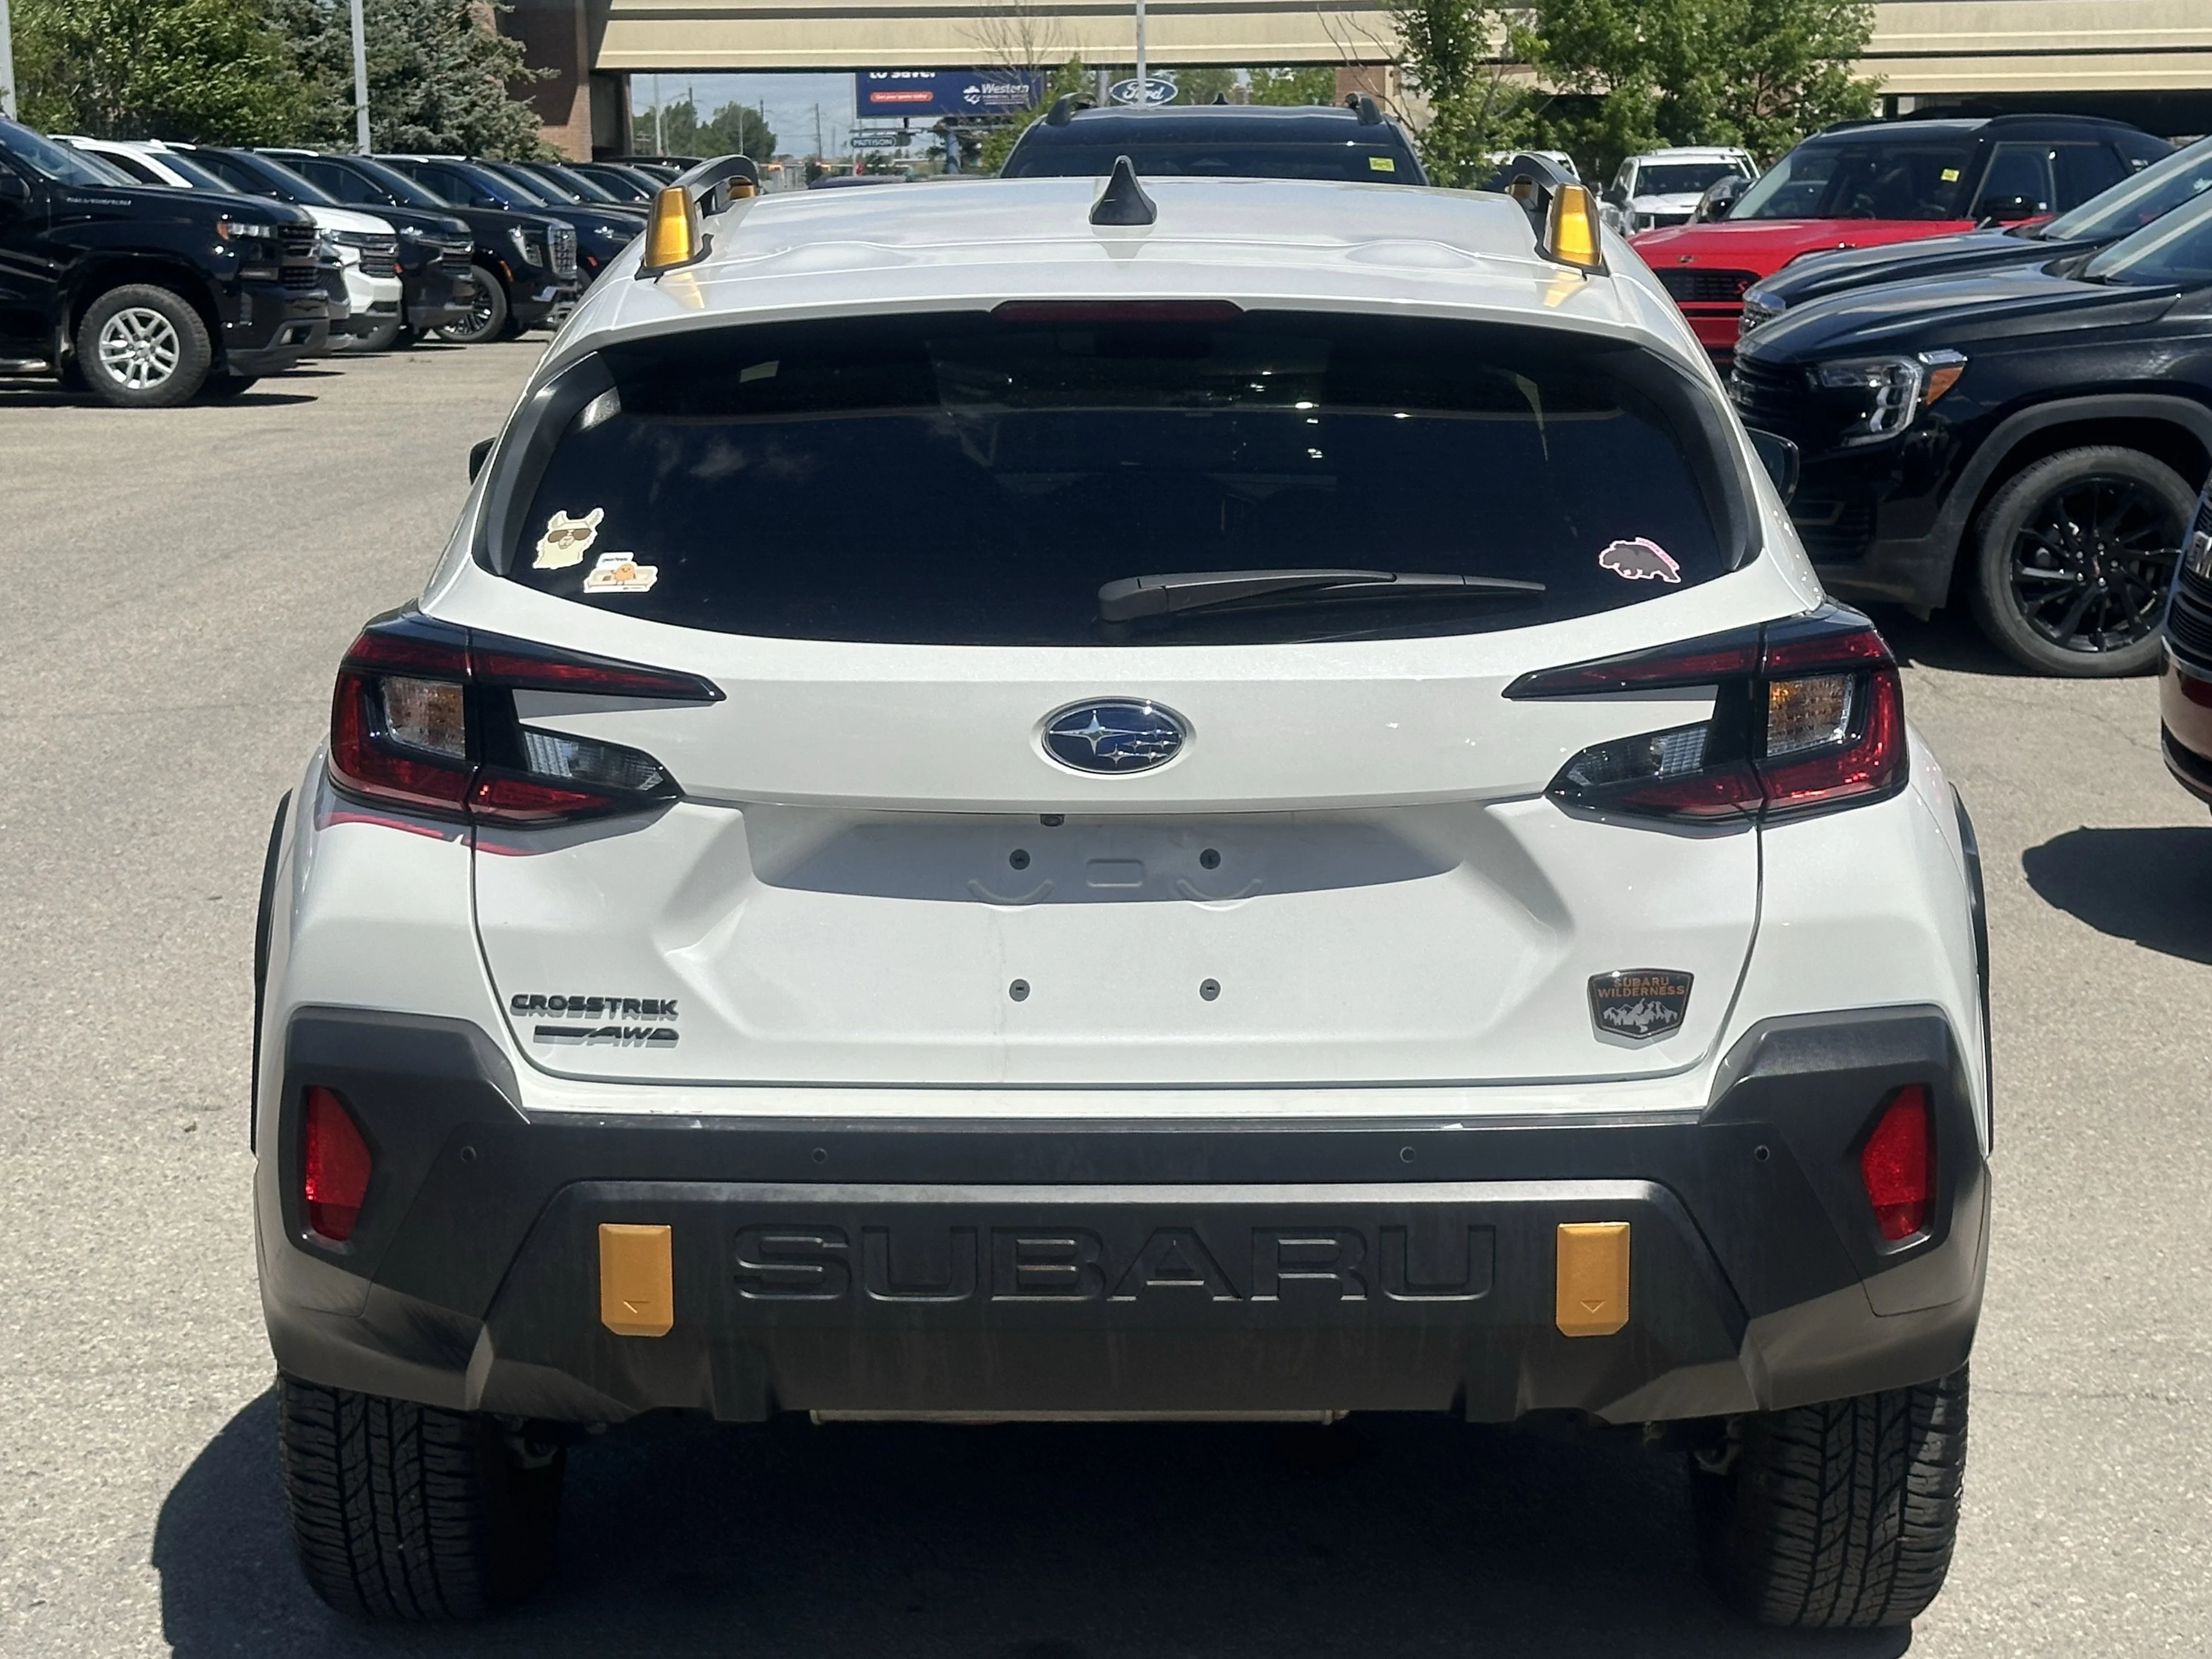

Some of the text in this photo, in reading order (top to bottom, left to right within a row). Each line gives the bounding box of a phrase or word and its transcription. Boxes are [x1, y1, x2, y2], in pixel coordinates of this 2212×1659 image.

[1613, 976, 1669, 988] SUBARU
[1597, 985, 1685, 998] WILDERNESS
[511, 994, 679, 1015] CROSSTREK
[588, 1026, 680, 1041] AWD
[733, 1223, 1497, 1302] SUBARU
